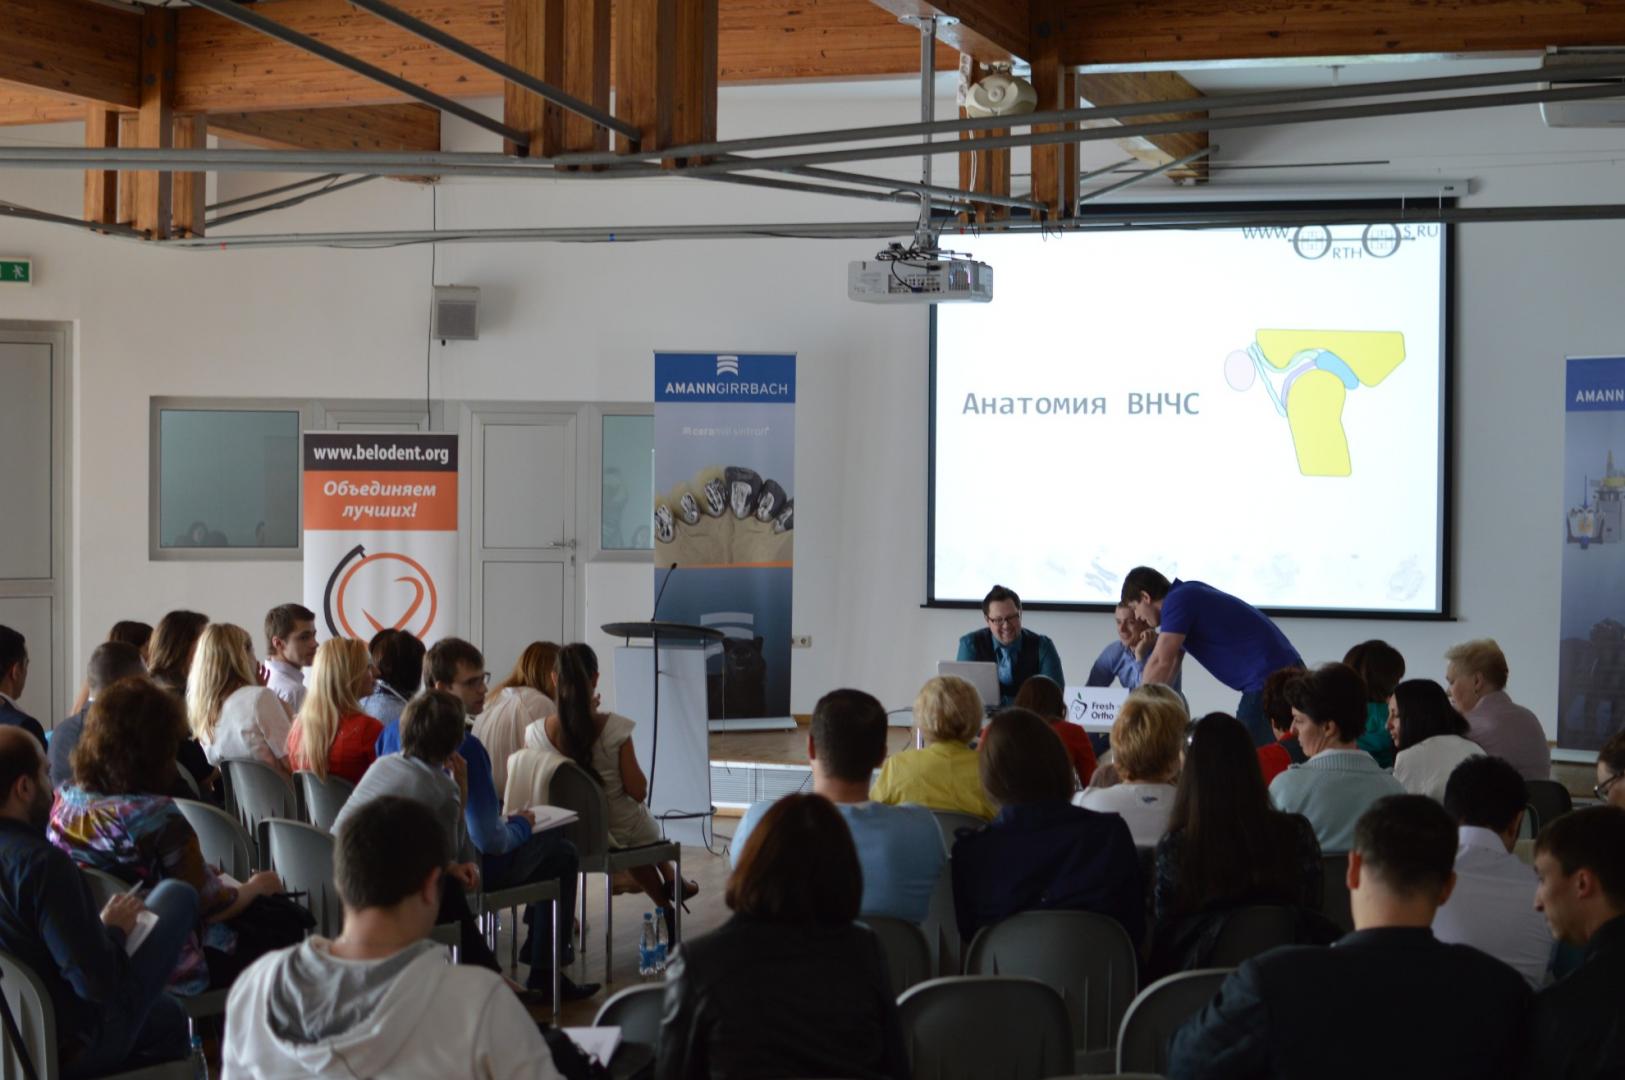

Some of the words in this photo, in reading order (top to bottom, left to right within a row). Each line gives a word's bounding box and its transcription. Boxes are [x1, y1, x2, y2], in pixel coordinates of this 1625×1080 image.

[665, 382, 788, 395] AMANNGIRRBACH
[1575, 389, 1624, 402] AMANN
[962, 392, 1107, 415] Анатомия
[1127, 392, 1200, 415] ВНЧС
[313, 443, 449, 465] www.belodent.org
[323, 480, 436, 497] Объединяем
[342, 502, 417, 521] лучших!
[1091, 702, 1115, 711] Fresh
[1091, 711, 1114, 720] Ortho
